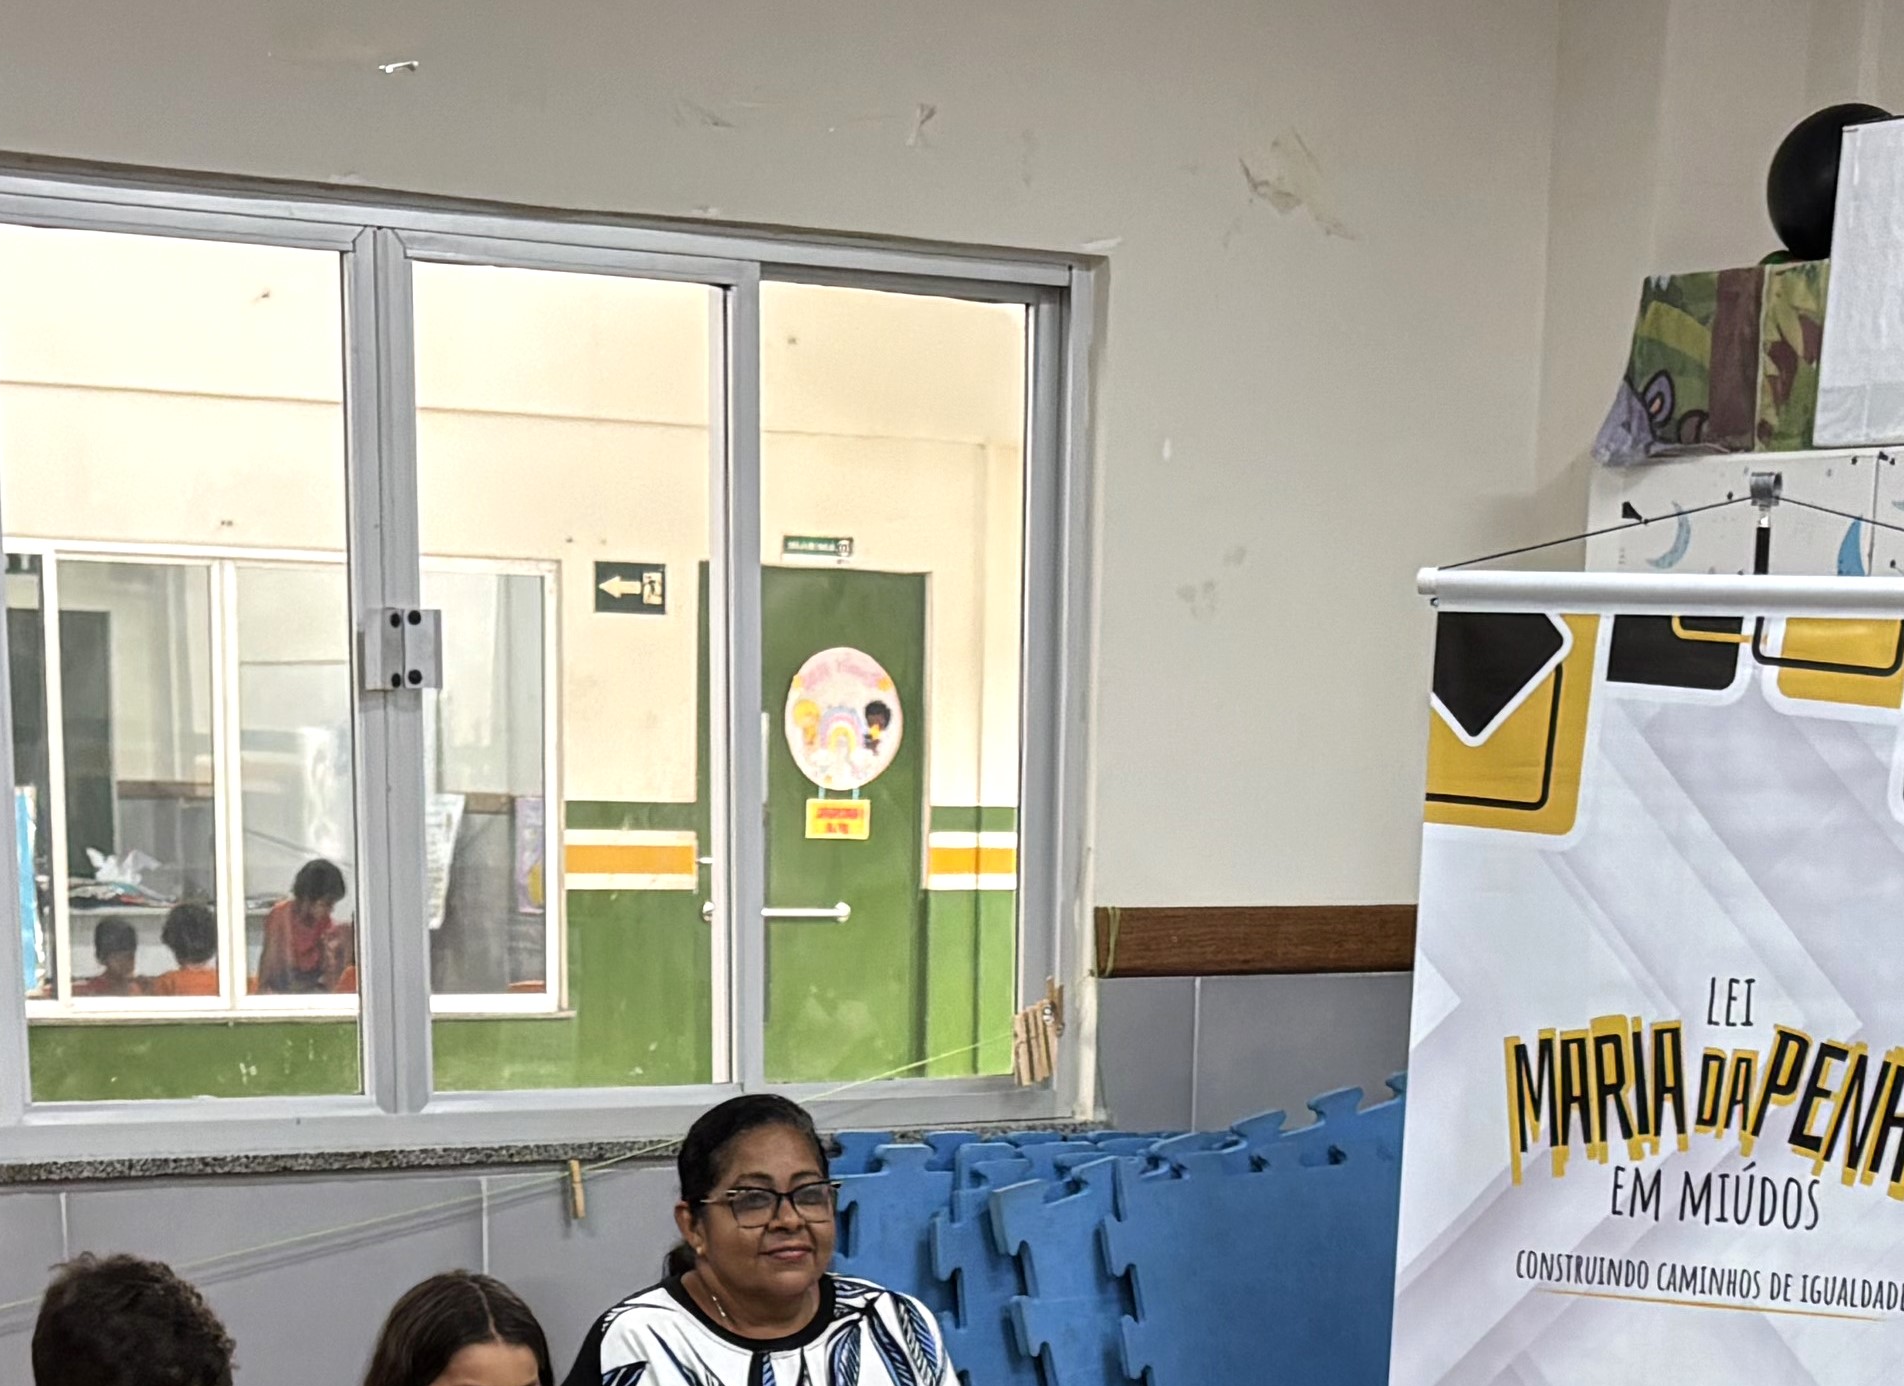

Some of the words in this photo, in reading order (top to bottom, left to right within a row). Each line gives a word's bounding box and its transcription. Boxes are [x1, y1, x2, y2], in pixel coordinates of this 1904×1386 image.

[1707, 977, 1756, 1027] LEI
[1510, 1020, 1688, 1167] MARIA
[1696, 1050, 1756, 1139] DA
[1611, 1165, 1662, 1222] EM
[1679, 1161, 1820, 1231] MIÚDOS
[1516, 1249, 1650, 1290] CONSTRUINDO
[1656, 1261, 1761, 1300] CAMINHOS
[1769, 1272, 1793, 1303] DE
